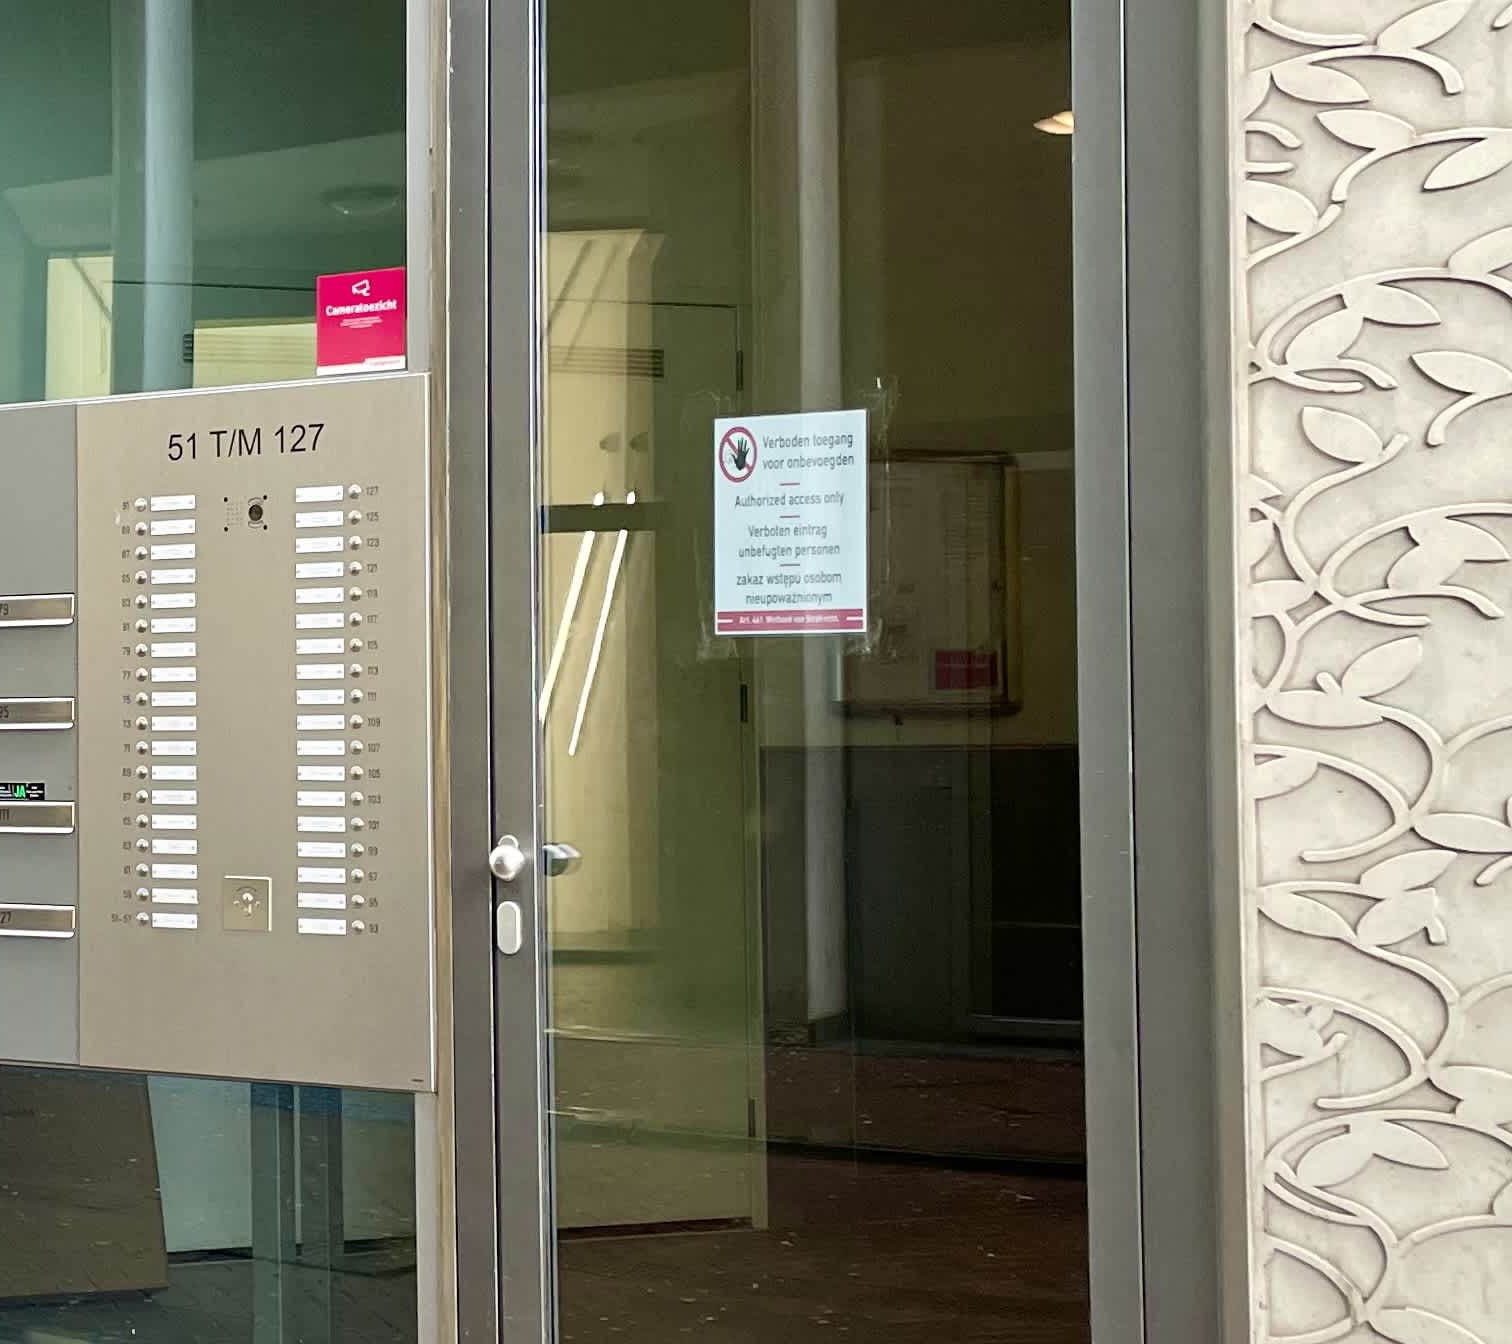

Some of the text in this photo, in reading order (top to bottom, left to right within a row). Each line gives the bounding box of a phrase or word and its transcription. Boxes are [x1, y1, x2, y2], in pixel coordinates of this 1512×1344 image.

[326, 299, 397, 316] Cameratoezicht
[168, 424, 324, 461] 51 T/M 127
[763, 434, 853, 449] Verboden toegang
[763, 456, 854, 472] voor onbevoegden
[367, 486, 378, 495] 127
[735, 491, 844, 507] Authorized access only
[367, 512, 378, 521] 125
[748, 525, 827, 538] Verboten eintrag
[367, 538, 379, 547] 123
[739, 544, 840, 560] unbefugten personen
[737, 573, 841, 588] zakaz wstępu osobom
[0, 603, 8, 615] 79
[123, 671, 130, 679] 77
[368, 692, 376, 701] 111
[368, 718, 380, 727] 109
[124, 744, 130, 752] 71
[368, 744, 380, 752] 107
[15, 785, 25, 798] JA
